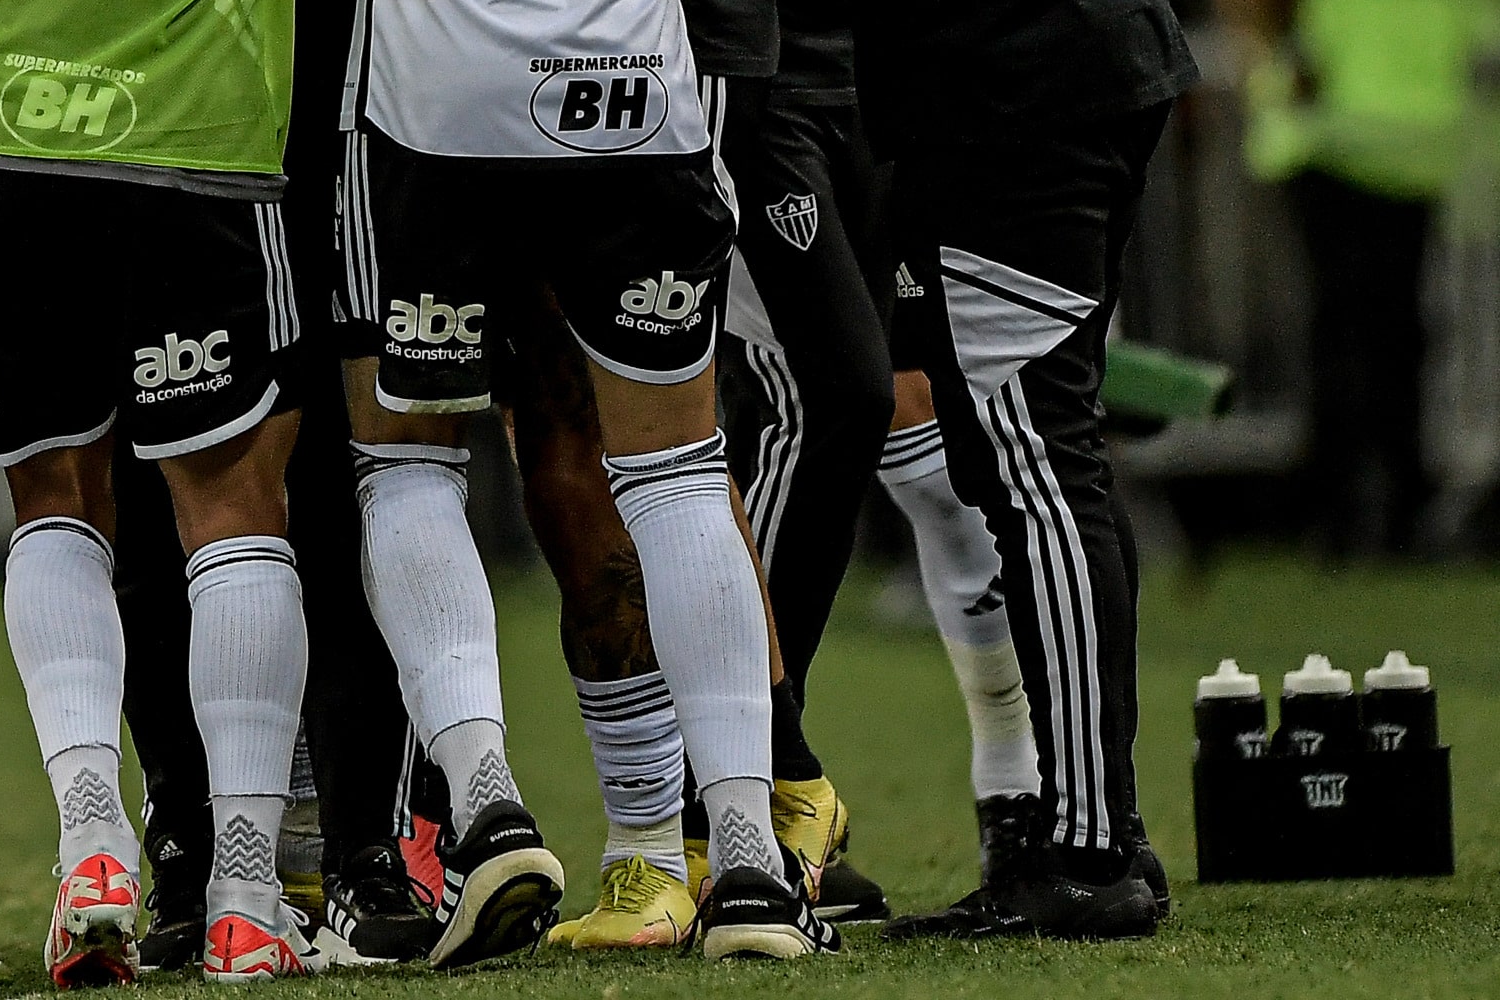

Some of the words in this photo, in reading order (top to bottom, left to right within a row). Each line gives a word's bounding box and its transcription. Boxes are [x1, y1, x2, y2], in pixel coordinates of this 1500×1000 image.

[3, 53, 146, 85] SUPERMERCADOS
[529, 55, 664, 74] SUPERMERCADOS
[16, 80, 117, 137] BH
[557, 76, 650, 132] BH
[386, 293, 486, 344] abc
[615, 312, 635, 328] da
[133, 329, 231, 388] abc
[385, 340, 402, 357] da
[403, 345, 483, 364] construção
[135, 389, 156, 404] da
[157, 373, 233, 402] construção
